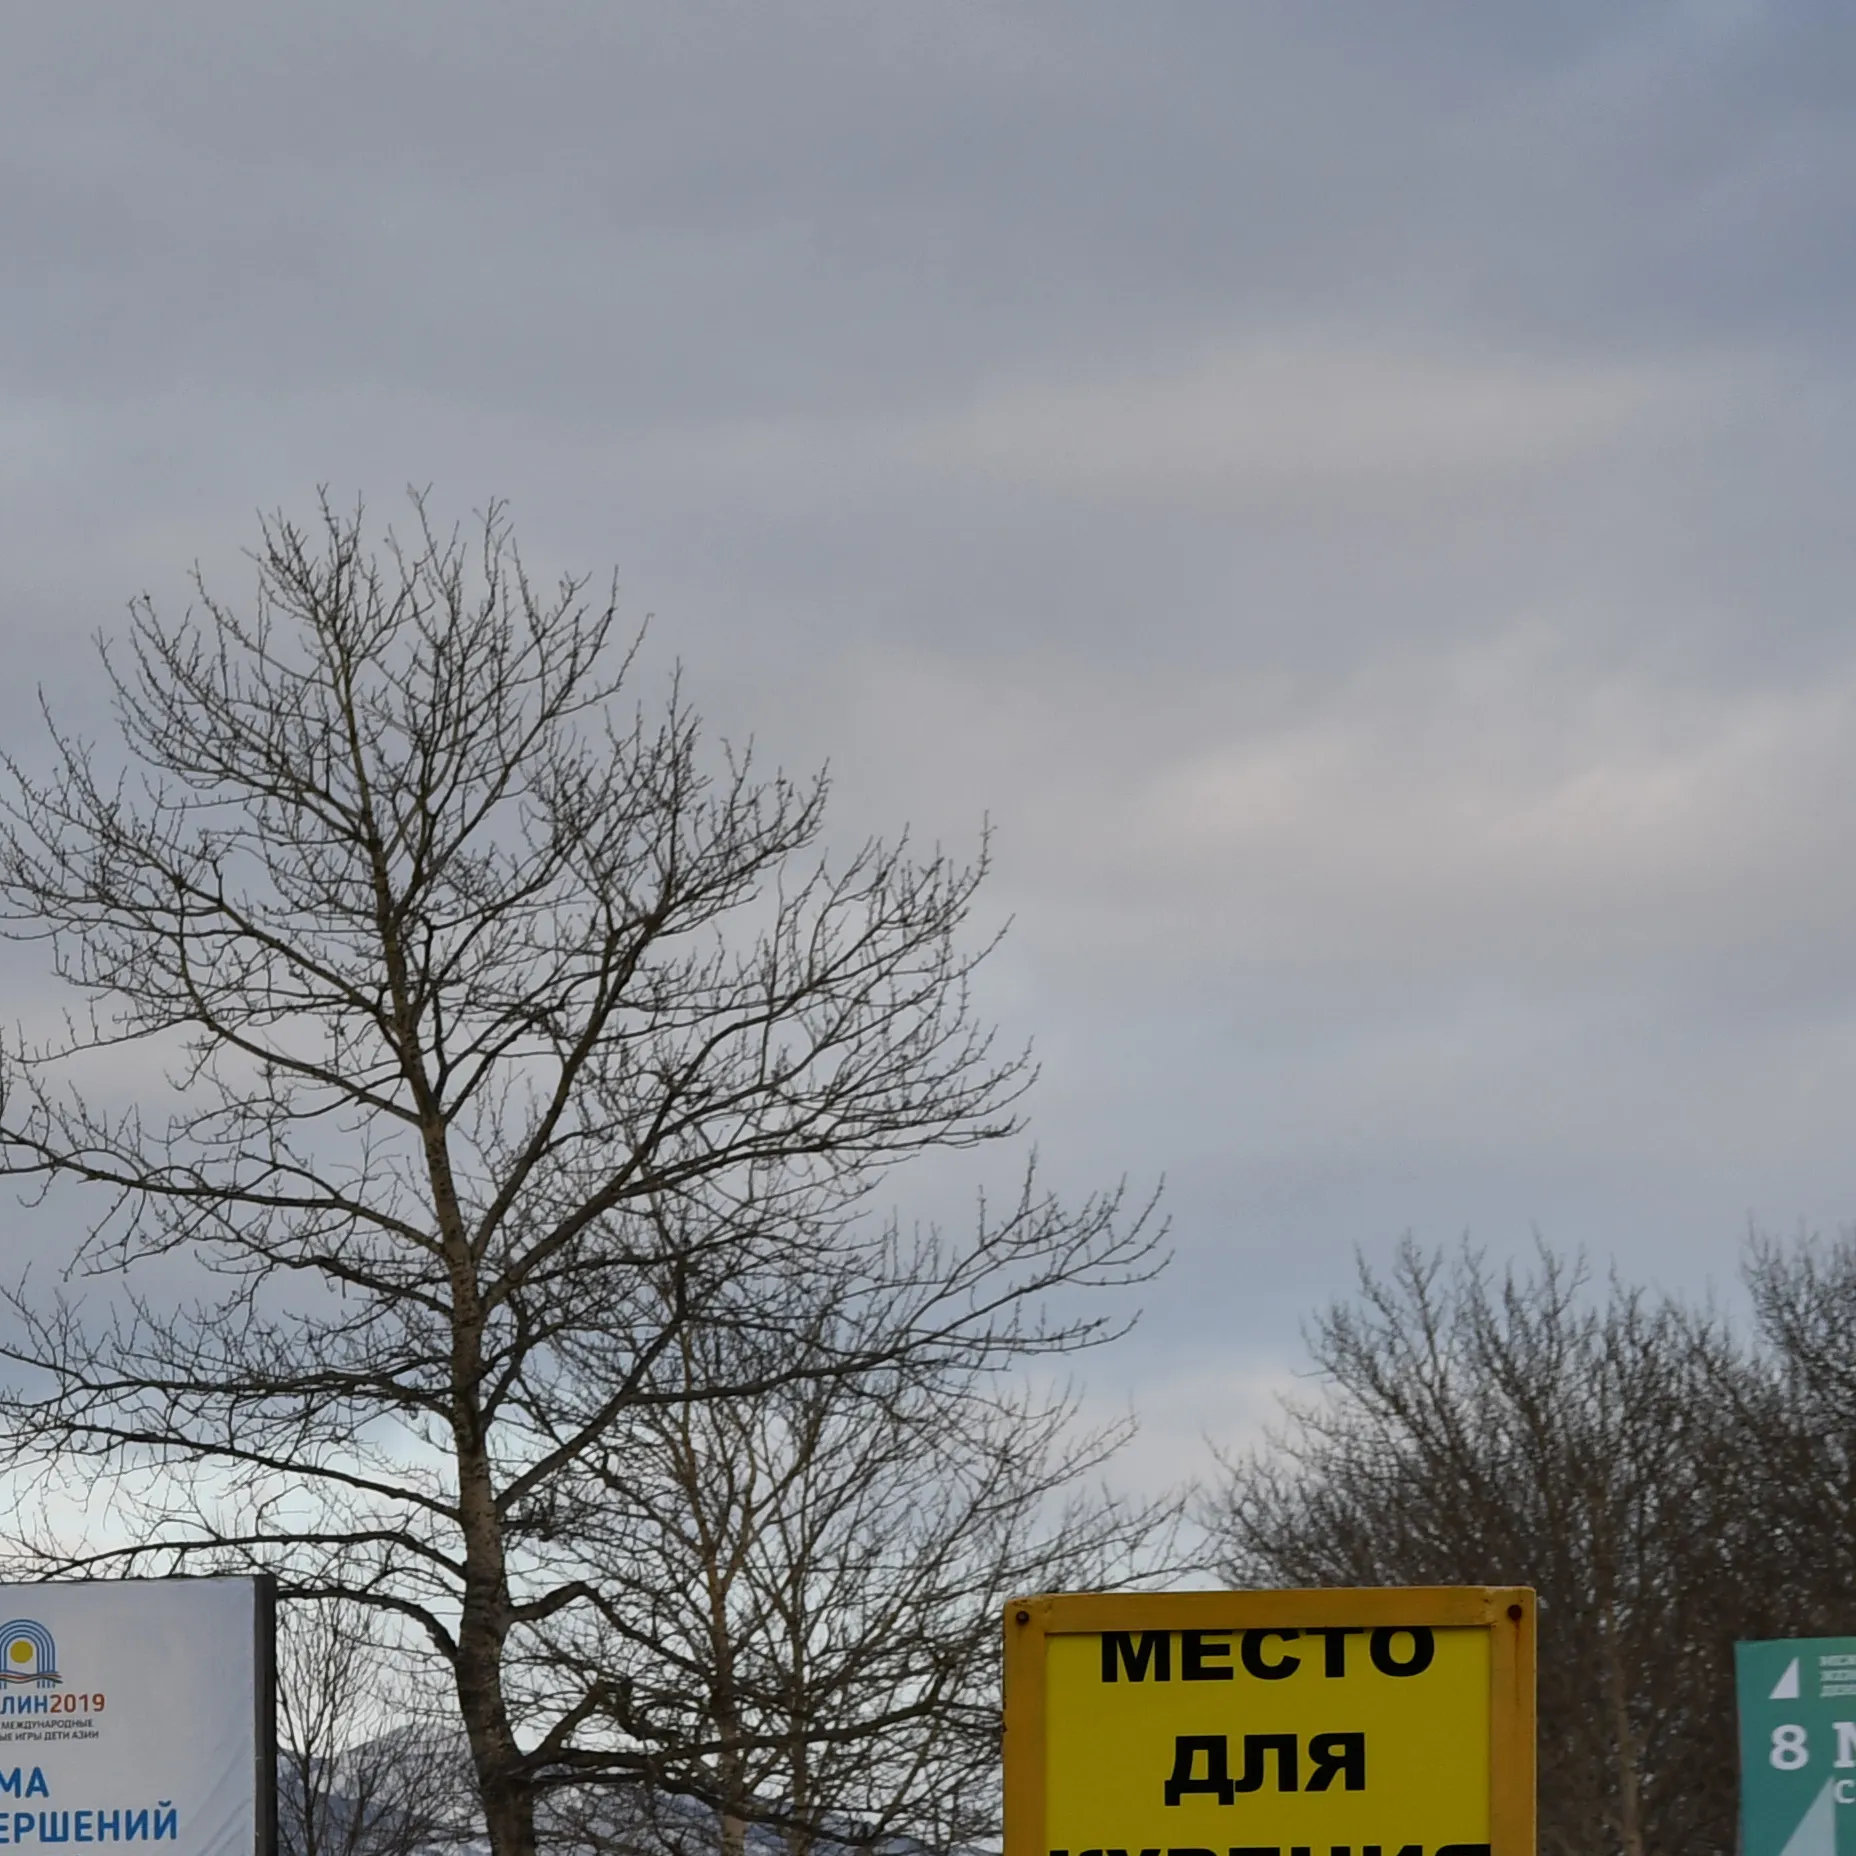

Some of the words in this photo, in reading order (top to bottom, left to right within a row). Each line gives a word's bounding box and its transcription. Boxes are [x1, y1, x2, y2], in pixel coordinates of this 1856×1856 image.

[1100, 1627, 1435, 1682] МЕСТО
[1, 1719, 93, 1730] МЕЖДУНАРОДНЫЕ
[14, 1732, 42, 1742] ИГРЫ
[44, 1731, 70, 1741] ДЕТИ
[71, 1730, 99, 1740] АЗИИ
[1769, 1723, 1809, 1771] 8
[1164, 1732, 1366, 1806] ДЛЯ
